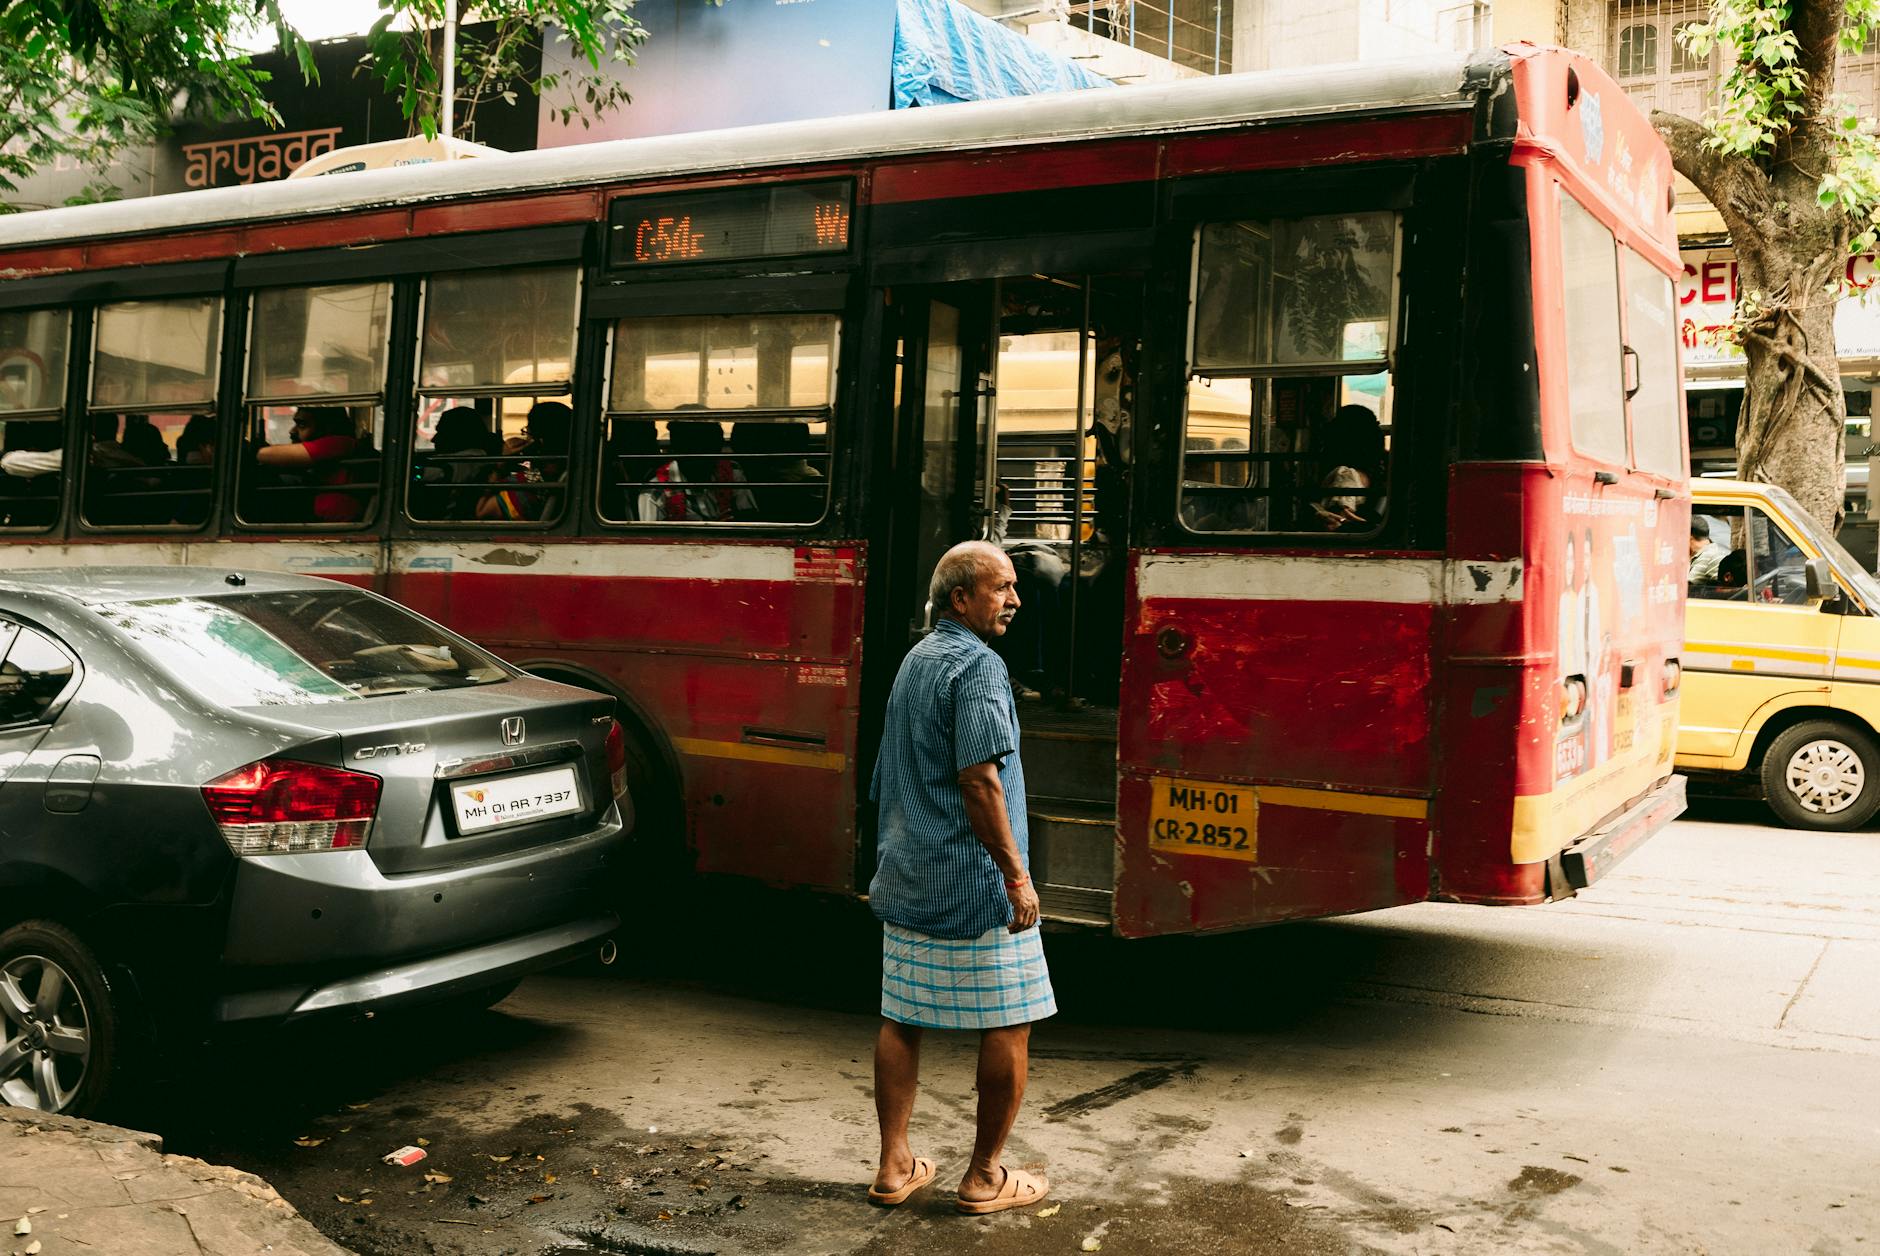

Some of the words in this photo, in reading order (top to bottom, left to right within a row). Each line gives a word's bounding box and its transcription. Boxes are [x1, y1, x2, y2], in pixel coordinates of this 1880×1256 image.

[496, 81, 512, 92] BY
[465, 806, 487, 819] MH
[510, 799, 530, 811] AR
[535, 790, 571, 806] 7337
